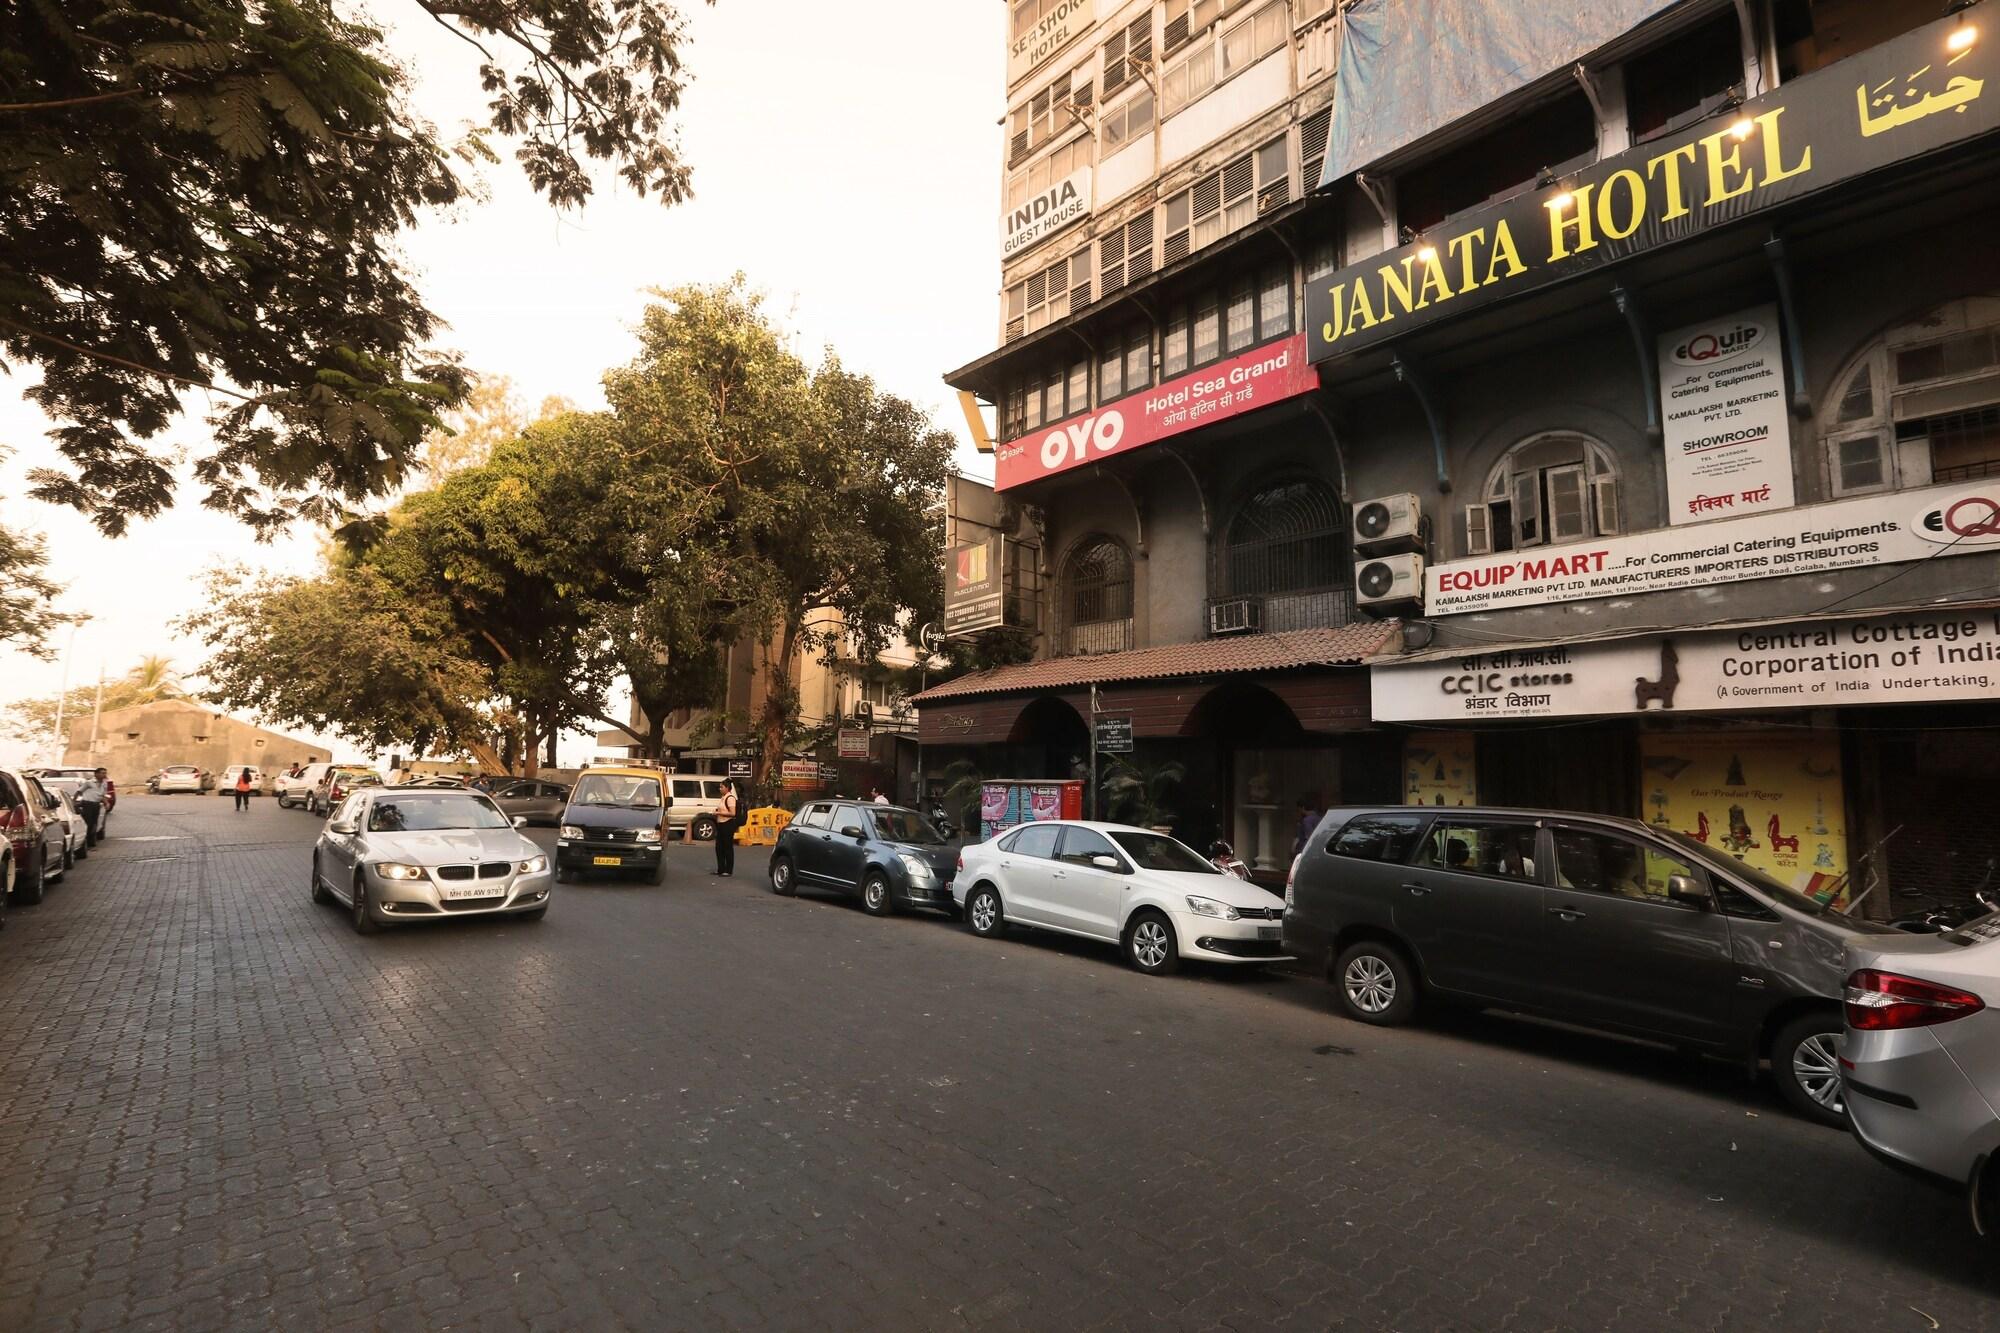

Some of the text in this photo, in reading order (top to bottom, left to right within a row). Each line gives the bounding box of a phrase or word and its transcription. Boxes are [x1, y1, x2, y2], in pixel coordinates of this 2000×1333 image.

[1039, 0, 1084, 37] SHOR
[1030, 25, 1070, 65] HOTEL
[1007, 180, 1077, 235] INDIA
[1004, 198, 1084, 253] GUEST HOUSE
[1322, 106, 1813, 343] JANATA HOTEL
[1721, 343, 1750, 355] MART
[1145, 350, 1288, 415] Hotel Sea Grand
[1671, 369, 1774, 399] Catering Equipments.
[1708, 359, 1764, 380] Commercial
[1219, 391, 1234, 408] सी
[1668, 390, 1780, 421] KAMALAKSHI MARKETING
[1725, 409, 1742, 419] LTD.
[1040, 410, 1125, 470] OYO
[1683, 425, 1768, 451] SHOWROOM
[1741, 484, 1771, 504] मार्ट
[1651, 544, 1730, 564] Commercial
[1733, 537, 1796, 553] Catering
[1801, 521, 1901, 543] Equipments.
[1435, 592, 1491, 607] KAMALAKSHI
[1492, 585, 1545, 600] MARKETING
[1567, 579, 1587, 591] LTD.
[1590, 566, 1691, 588] MANUFACTURERS
[1694, 556, 1769, 575] IMPORTERS
[1773, 541, 1880, 566] DISTRIBUTORS
[1562, 591, 1583, 600] Kamal
[1615, 584, 1627, 593] 1st
[1649, 580, 1666, 590] Near
[1667, 577, 1689, 588] Radio
[1711, 571, 1737, 583] Arthur
[1738, 565, 1766, 579] Bunder
[1768, 562, 1793, 575] Road,
[1794, 559, 1827, 573] Colaba,
[1829, 553, 1864, 569] Mumbai
[1737, 627, 1837, 652] Central
[1851, 617, 1978, 643] Cottage
[1722, 642, 2000, 678] Corporation of India
[1441, 672, 1573, 695] CCIC stores
[1732, 682, 1804, 697] Government
[1811, 682, 1826, 692] of
[1835, 680, 1870, 692] India
[1465, 692, 1551, 709] भंडार विभाग
[1691, 788, 1783, 801] Our Product Range
